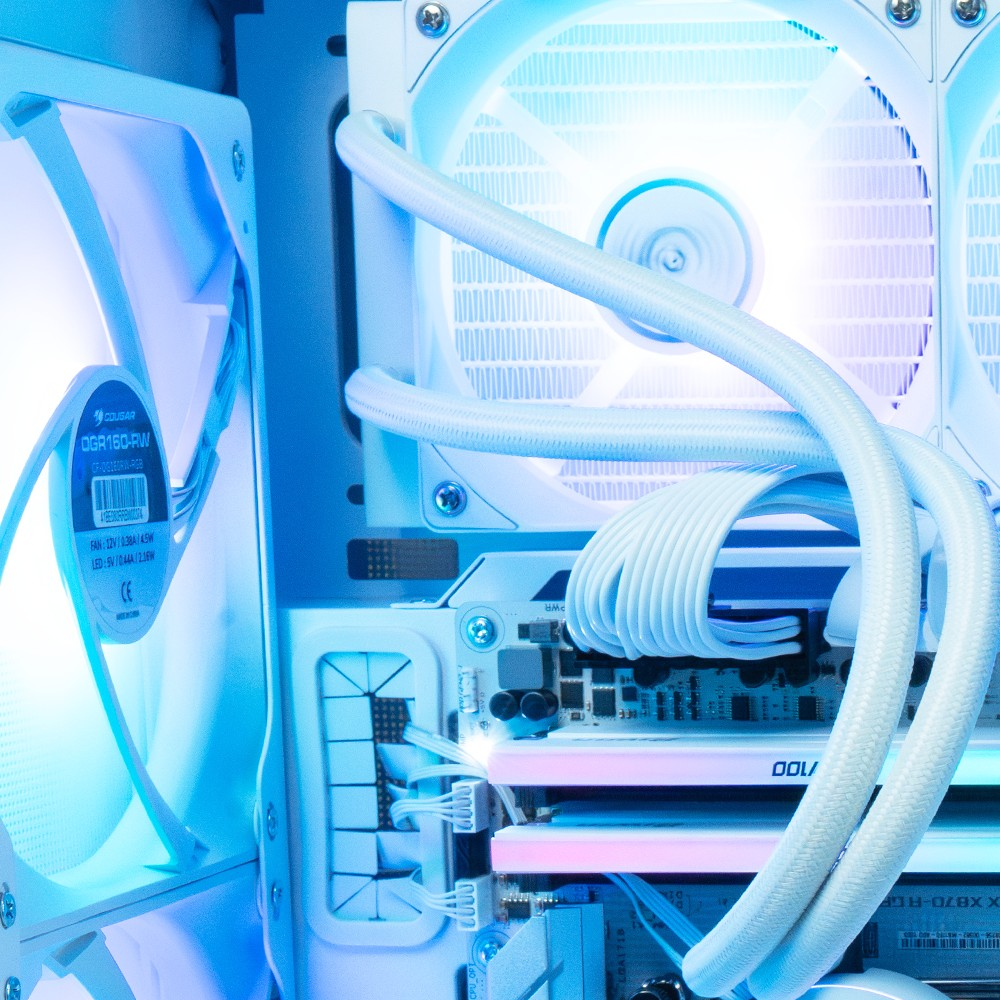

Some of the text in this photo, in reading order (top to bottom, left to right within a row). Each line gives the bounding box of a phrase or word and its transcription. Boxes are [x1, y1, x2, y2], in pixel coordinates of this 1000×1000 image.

[104, 411, 136, 421] COUGAR
[90, 540, 101, 551] FAN
[92, 558, 103, 570] LED
